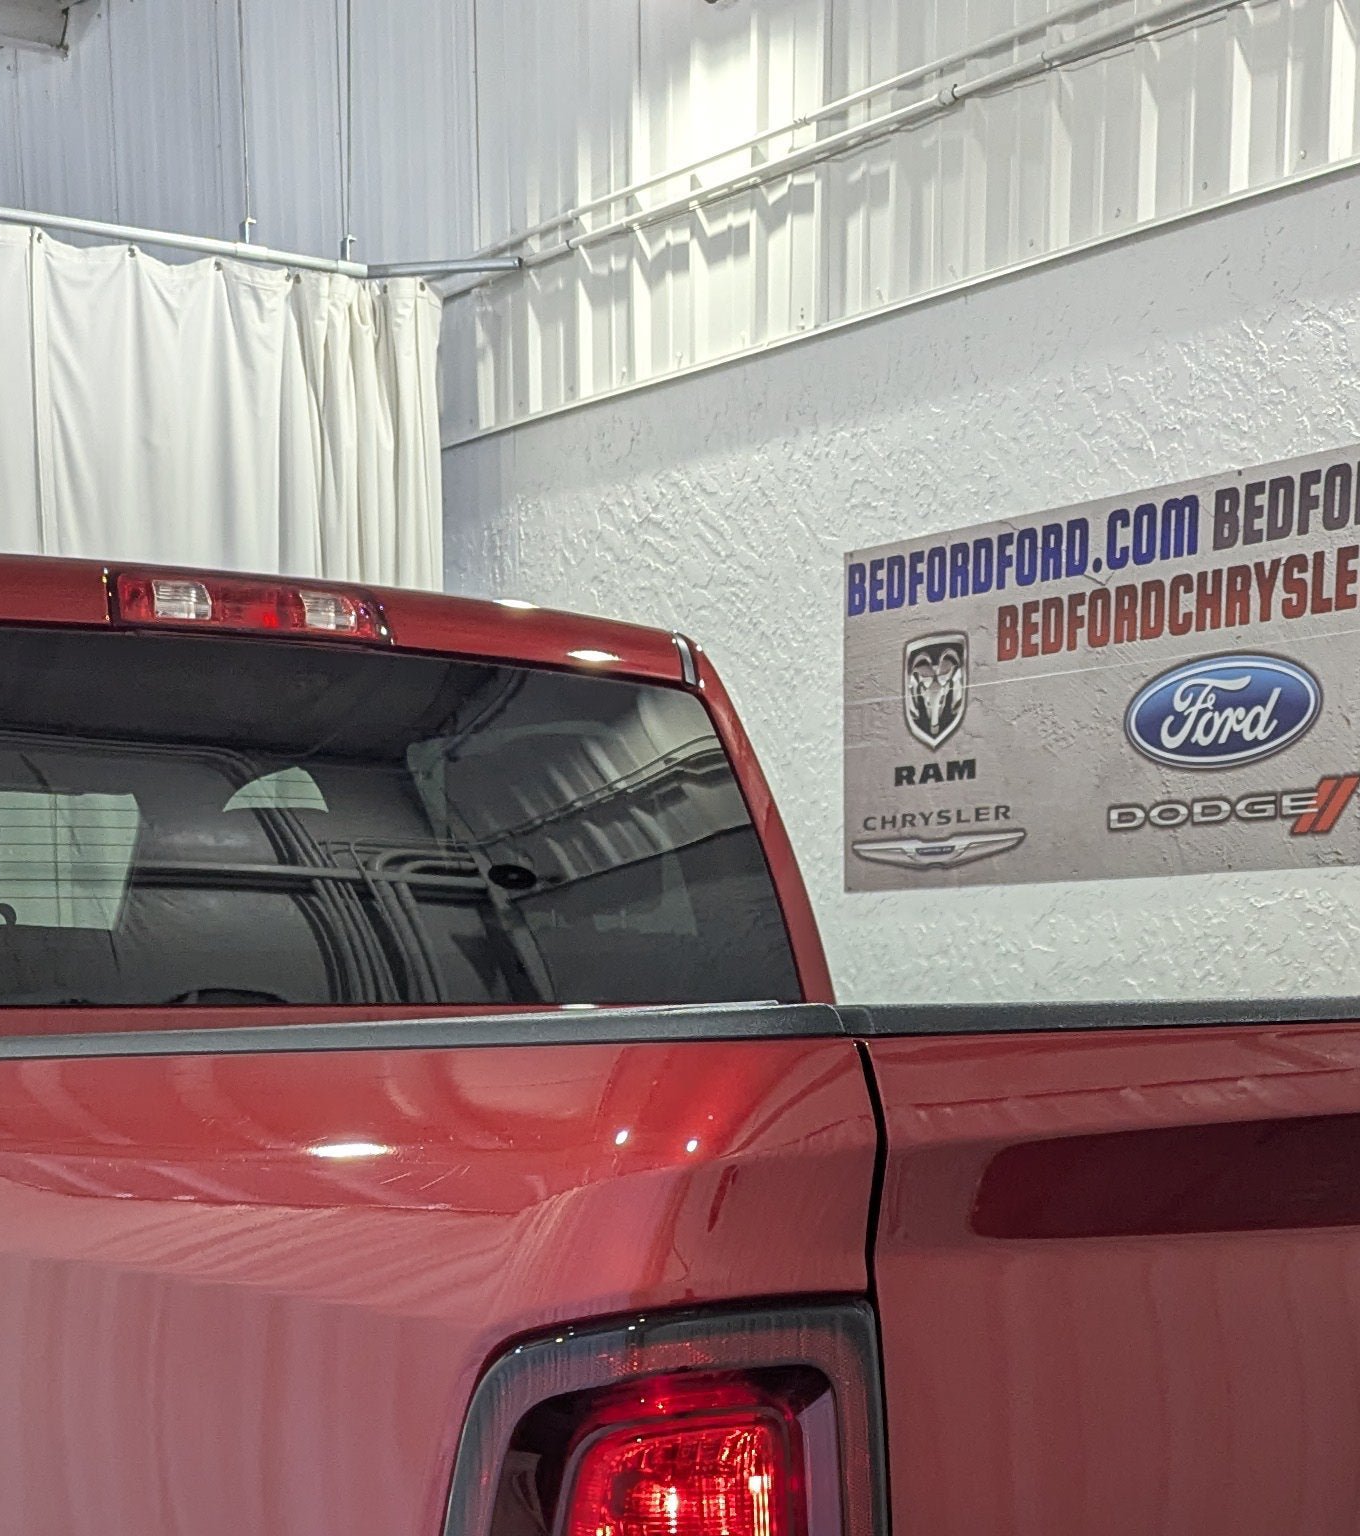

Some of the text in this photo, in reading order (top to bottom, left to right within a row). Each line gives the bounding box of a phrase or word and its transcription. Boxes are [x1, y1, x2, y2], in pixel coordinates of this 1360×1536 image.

[847, 494, 1200, 617] BEDFORDFORD.COM
[1160, 675, 1282, 749] Ford
[894, 758, 977, 787] RAM
[862, 804, 1011, 832] CHRYSLER
[1107, 787, 1320, 833] DODGE
